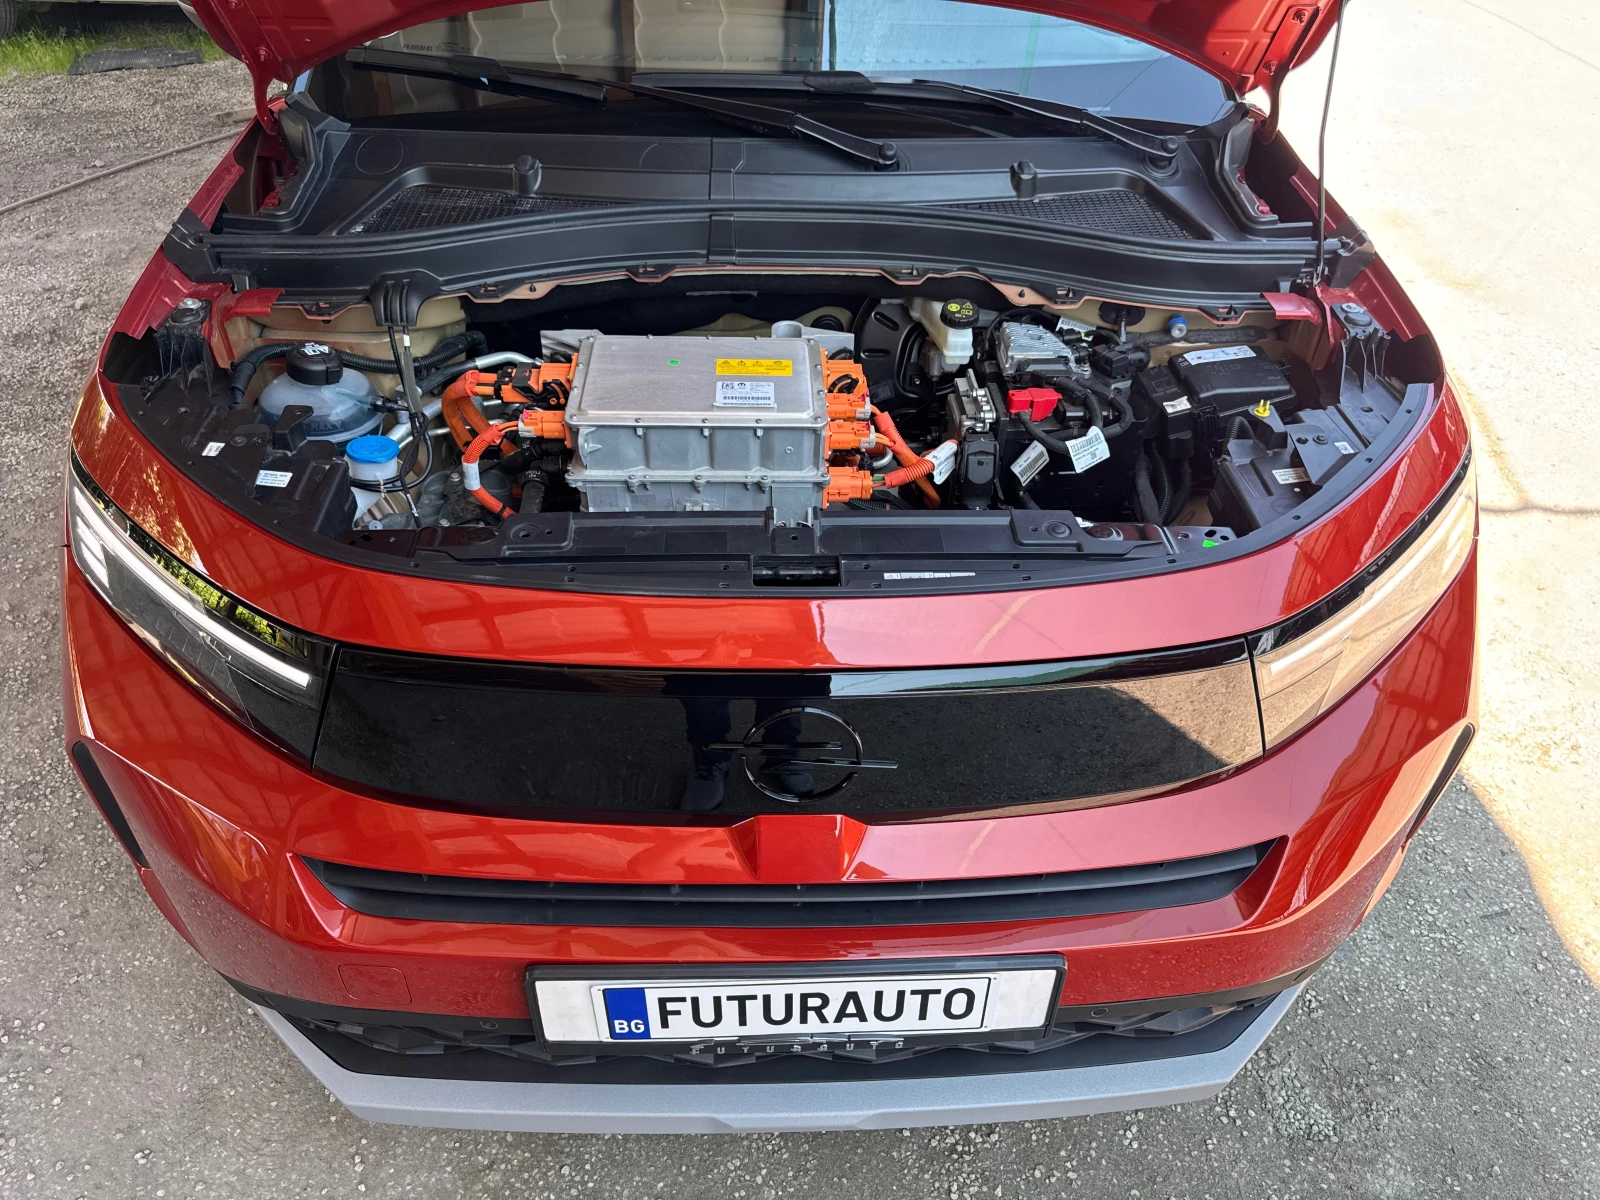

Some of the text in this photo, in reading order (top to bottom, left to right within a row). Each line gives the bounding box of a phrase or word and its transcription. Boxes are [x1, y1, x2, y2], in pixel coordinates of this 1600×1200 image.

[311, 422, 333, 430] MAX
[657, 988, 976, 1029] FUTURAUTO
[614, 1020, 645, 1034] BG
